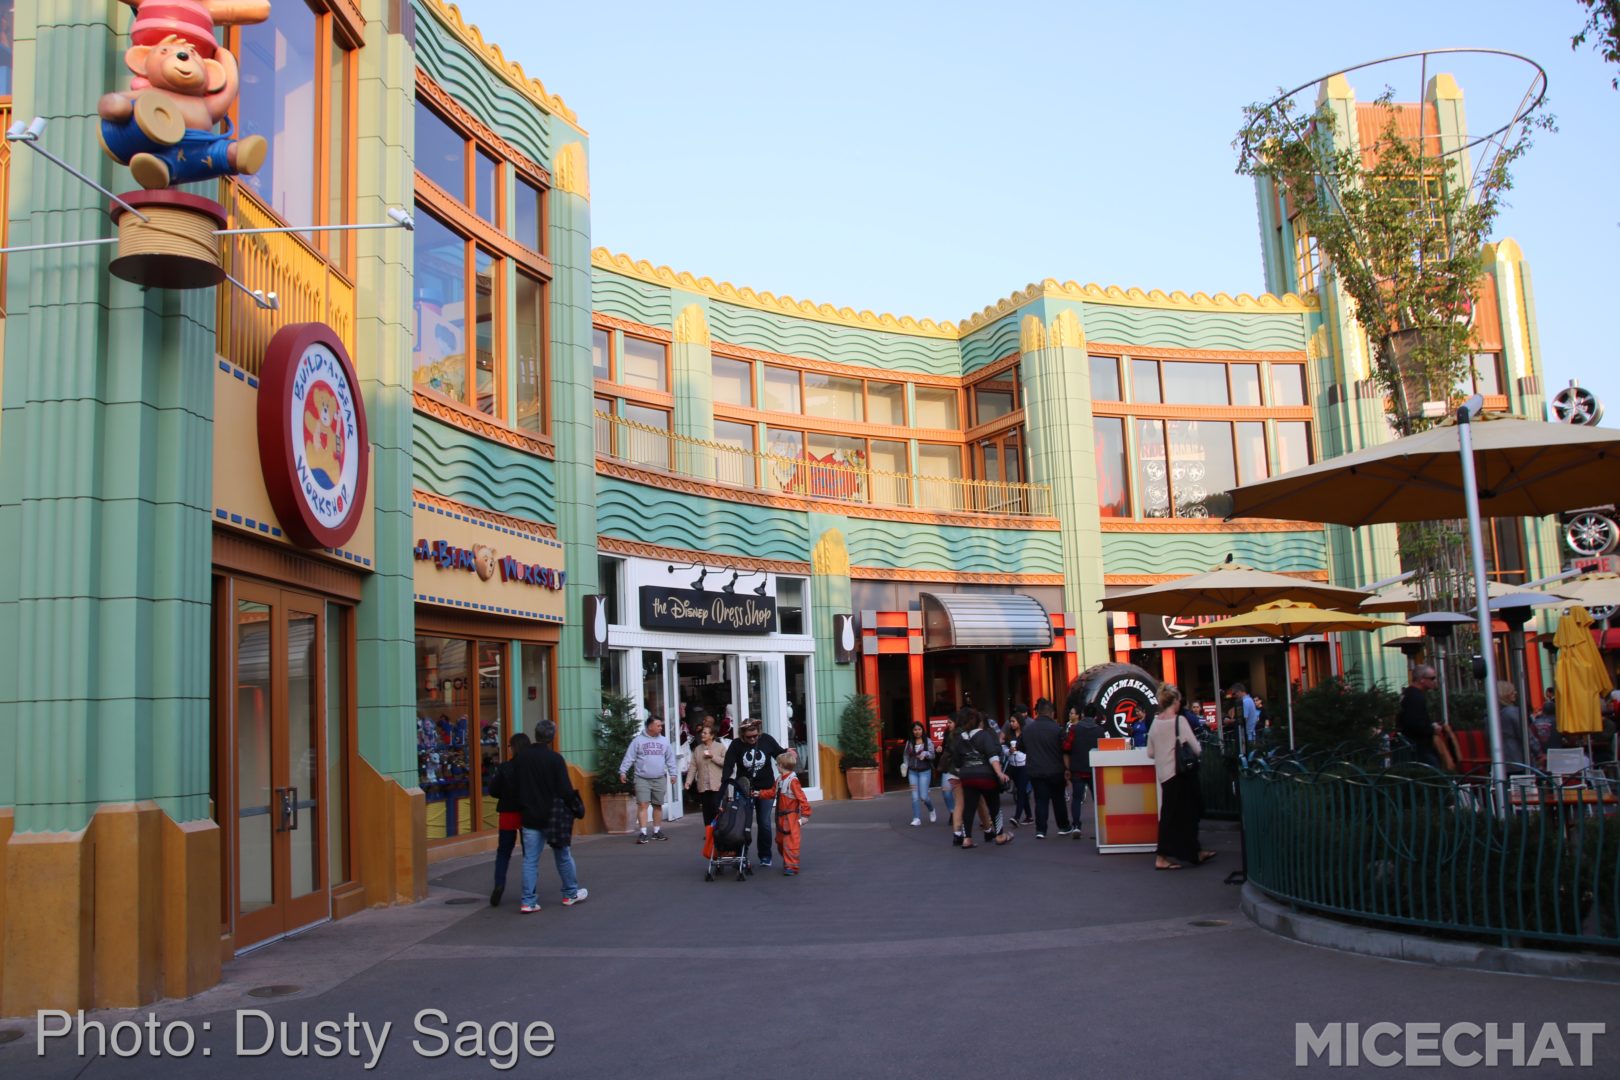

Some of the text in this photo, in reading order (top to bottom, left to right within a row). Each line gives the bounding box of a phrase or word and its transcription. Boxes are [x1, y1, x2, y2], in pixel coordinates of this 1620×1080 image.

[297, 455, 348, 517] WORKSHOP
[498, 555, 567, 590] WORKSHOP
[667, 596, 709, 626] Disney
[711, 597, 743, 628] Dress
[745, 599, 772, 628] Shop
[1100, 678, 1159, 710] RIDEMAKERZ
